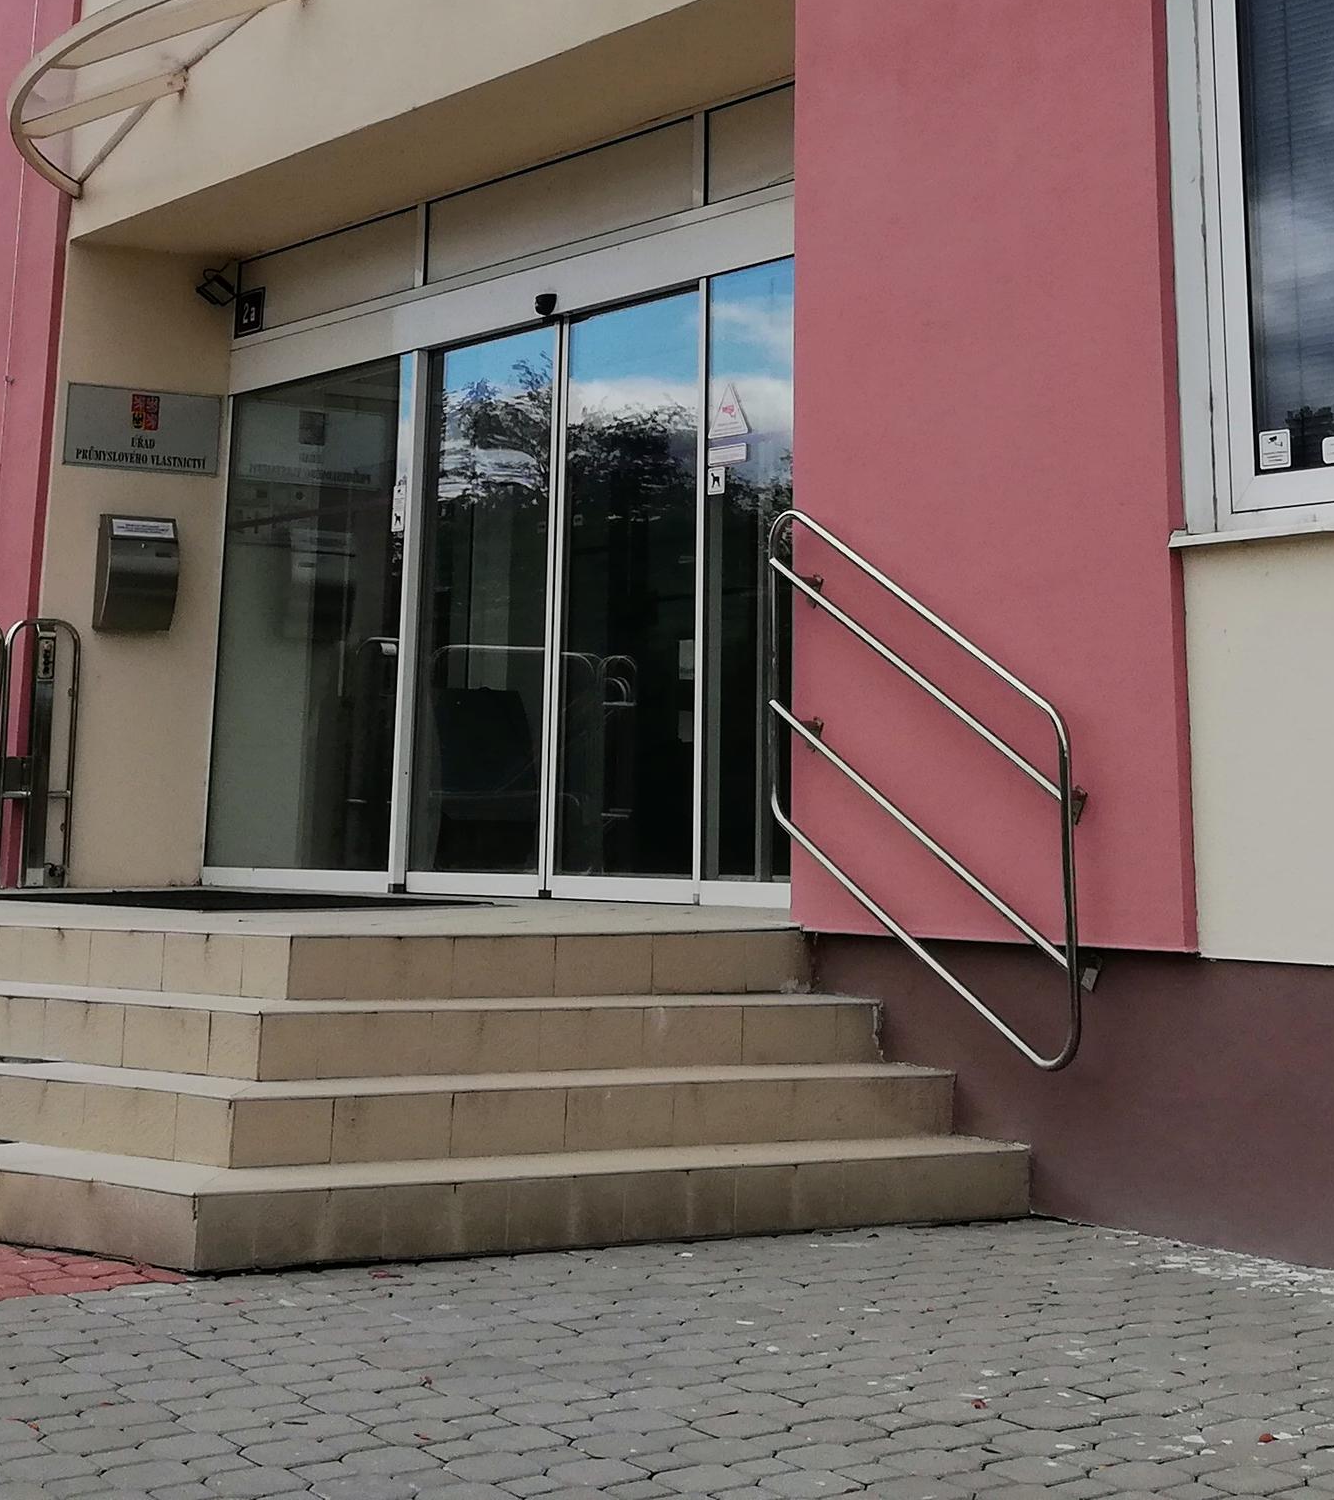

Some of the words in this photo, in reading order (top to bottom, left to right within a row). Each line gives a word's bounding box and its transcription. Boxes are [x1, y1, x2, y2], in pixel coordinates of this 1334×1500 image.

[242, 302, 256, 324] 2a
[131, 434, 155, 449] ÚŘAD
[75, 446, 148, 465] PRŮMYSLOVÉHO
[151, 455, 206, 469] VLASTNICTVÍ
